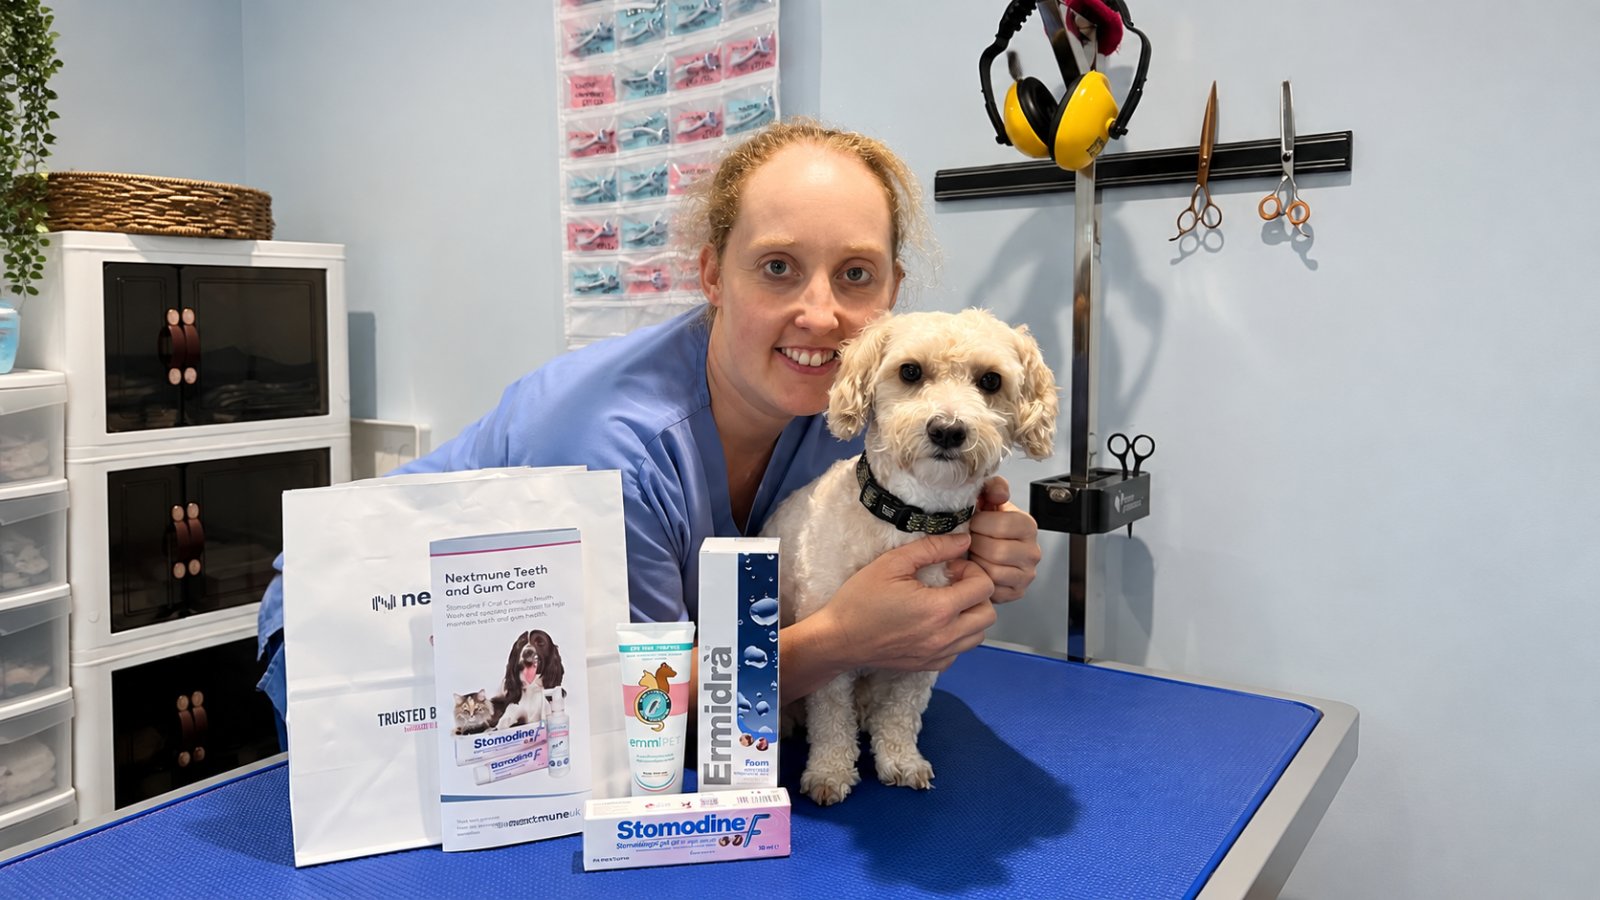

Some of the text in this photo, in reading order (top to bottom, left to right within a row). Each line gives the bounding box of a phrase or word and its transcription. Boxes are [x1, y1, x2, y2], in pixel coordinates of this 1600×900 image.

[445, 565, 548, 584] Nextmune Teeth
[445, 579, 536, 597] and Gum Care
[402, 591, 431, 607] ne
[378, 707, 437, 726] TRUSTED B
[474, 728, 534, 749] Stomodine
[617, 813, 771, 848] Stomodine F
